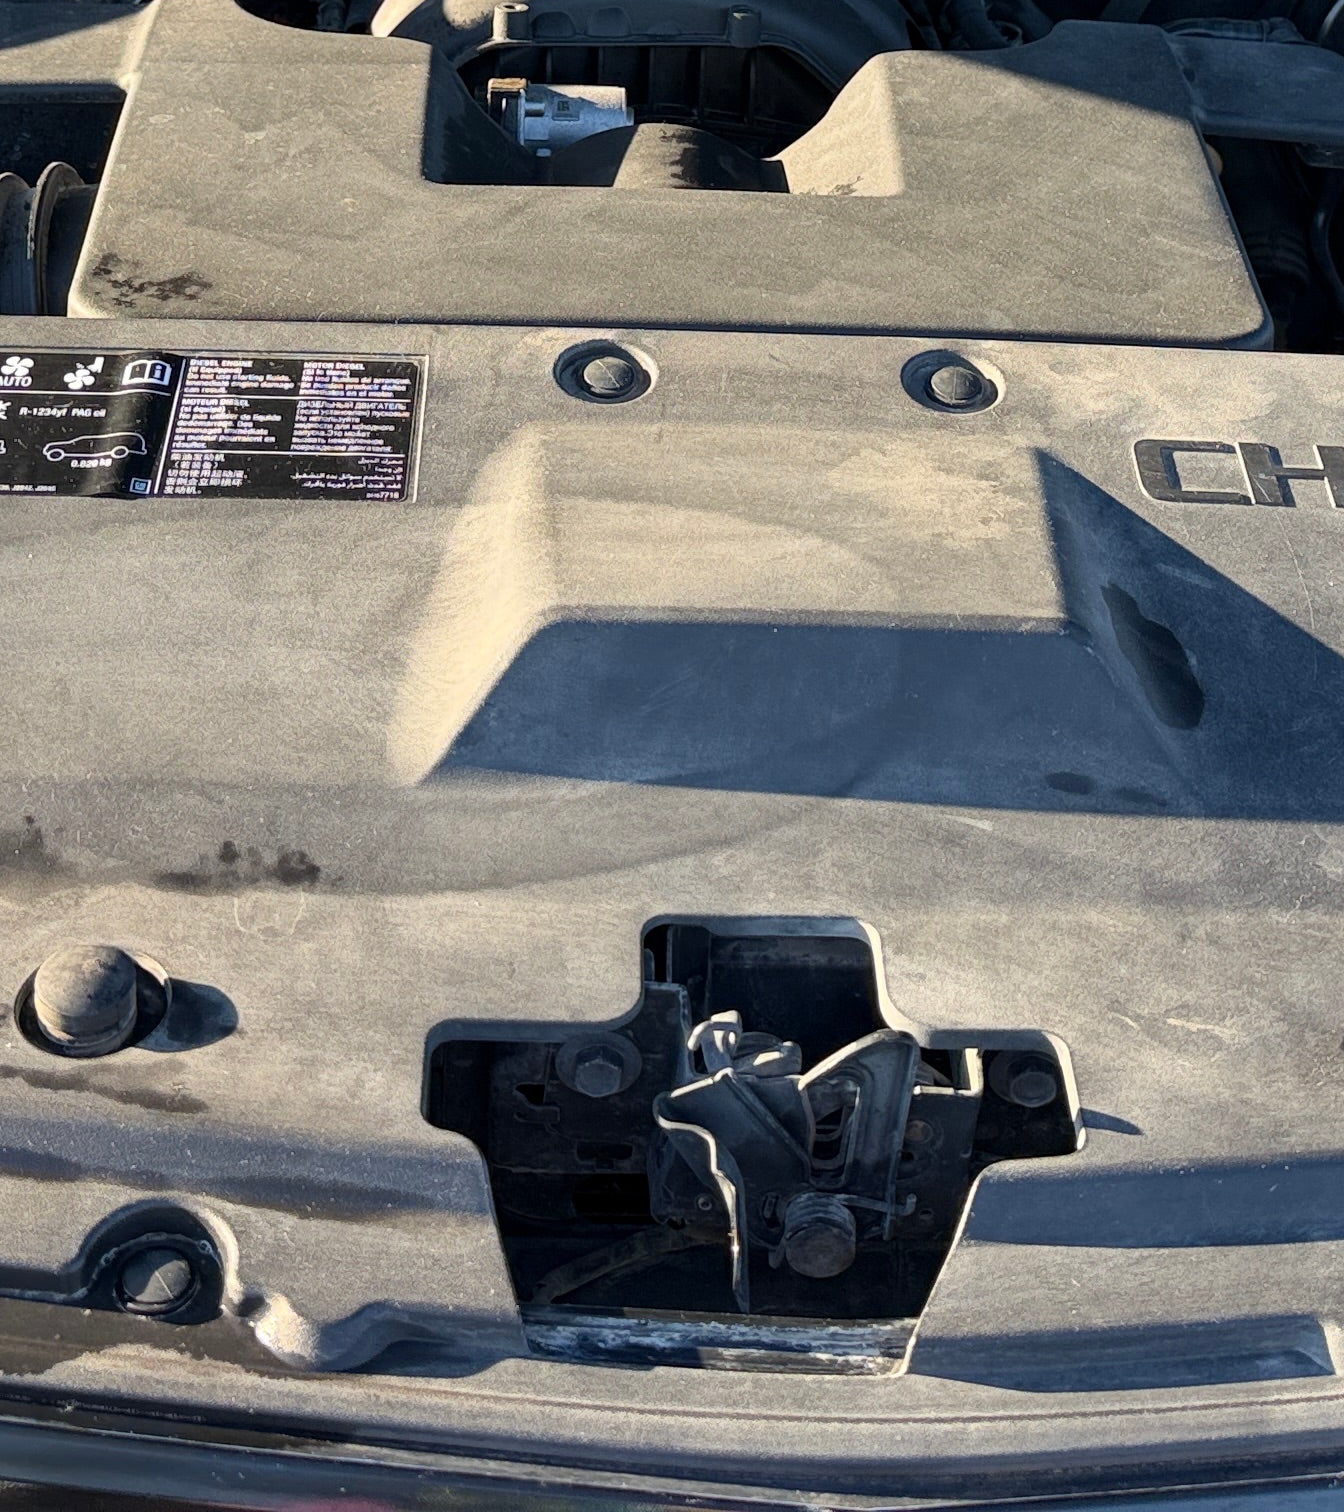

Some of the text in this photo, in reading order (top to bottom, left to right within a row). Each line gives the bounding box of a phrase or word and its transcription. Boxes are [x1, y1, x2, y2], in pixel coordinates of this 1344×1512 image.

[190, 359, 253, 367] DIESEL ENGINE
[260, 382, 295, 390] damage
[297, 400, 406, 411] ДИЗЕЛЬНЫЙ ДВИГАТЕЛЬ
[19, 407, 68, 418] R-1234yf
[72, 408, 92, 417] PAG
[100, 457, 112, 467] kg
